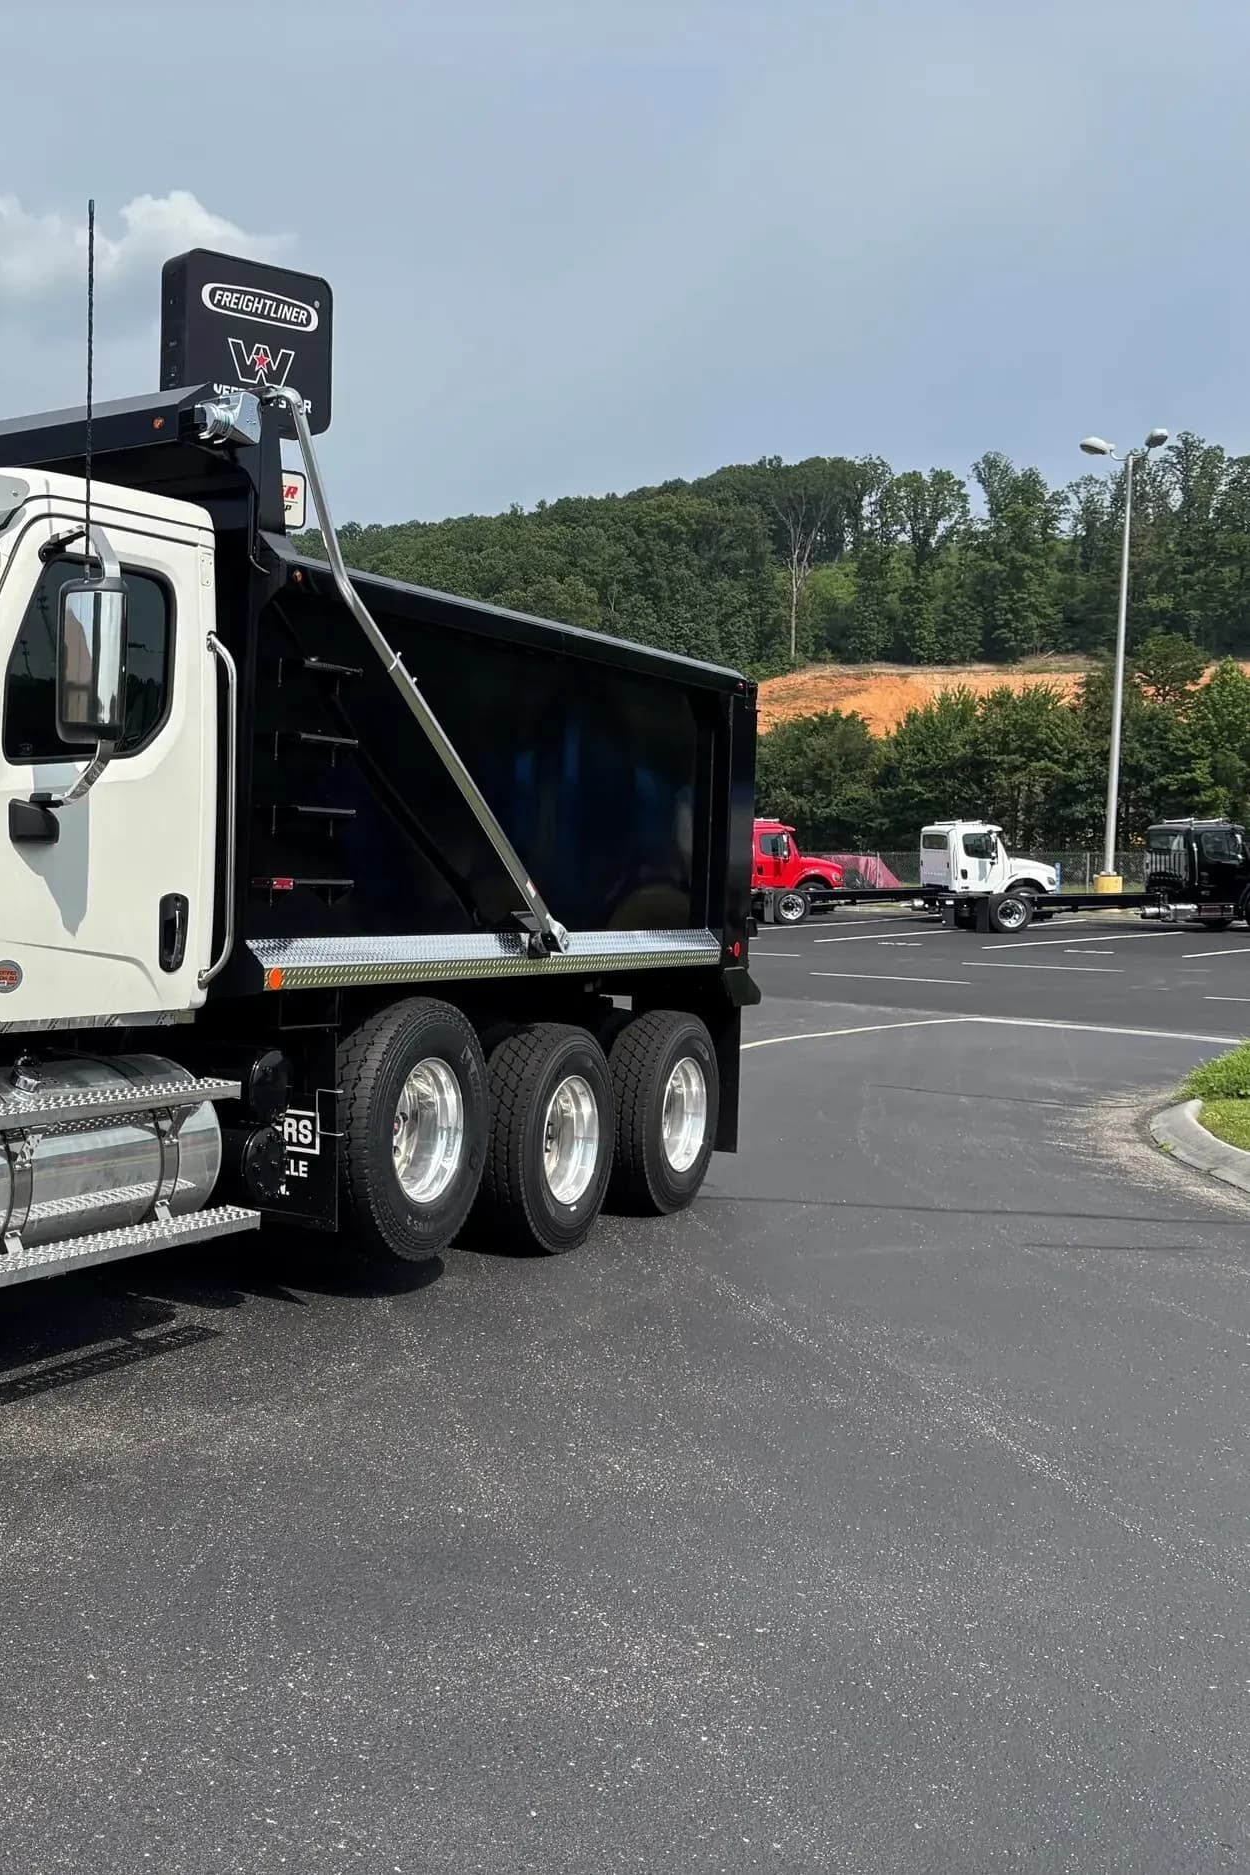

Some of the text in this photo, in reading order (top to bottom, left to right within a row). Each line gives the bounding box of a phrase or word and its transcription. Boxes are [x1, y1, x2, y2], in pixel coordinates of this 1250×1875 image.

[213, 290, 308, 325] FREIGHTLINER
[282, 485, 298, 499] R
[279, 1117, 313, 1145] RS
